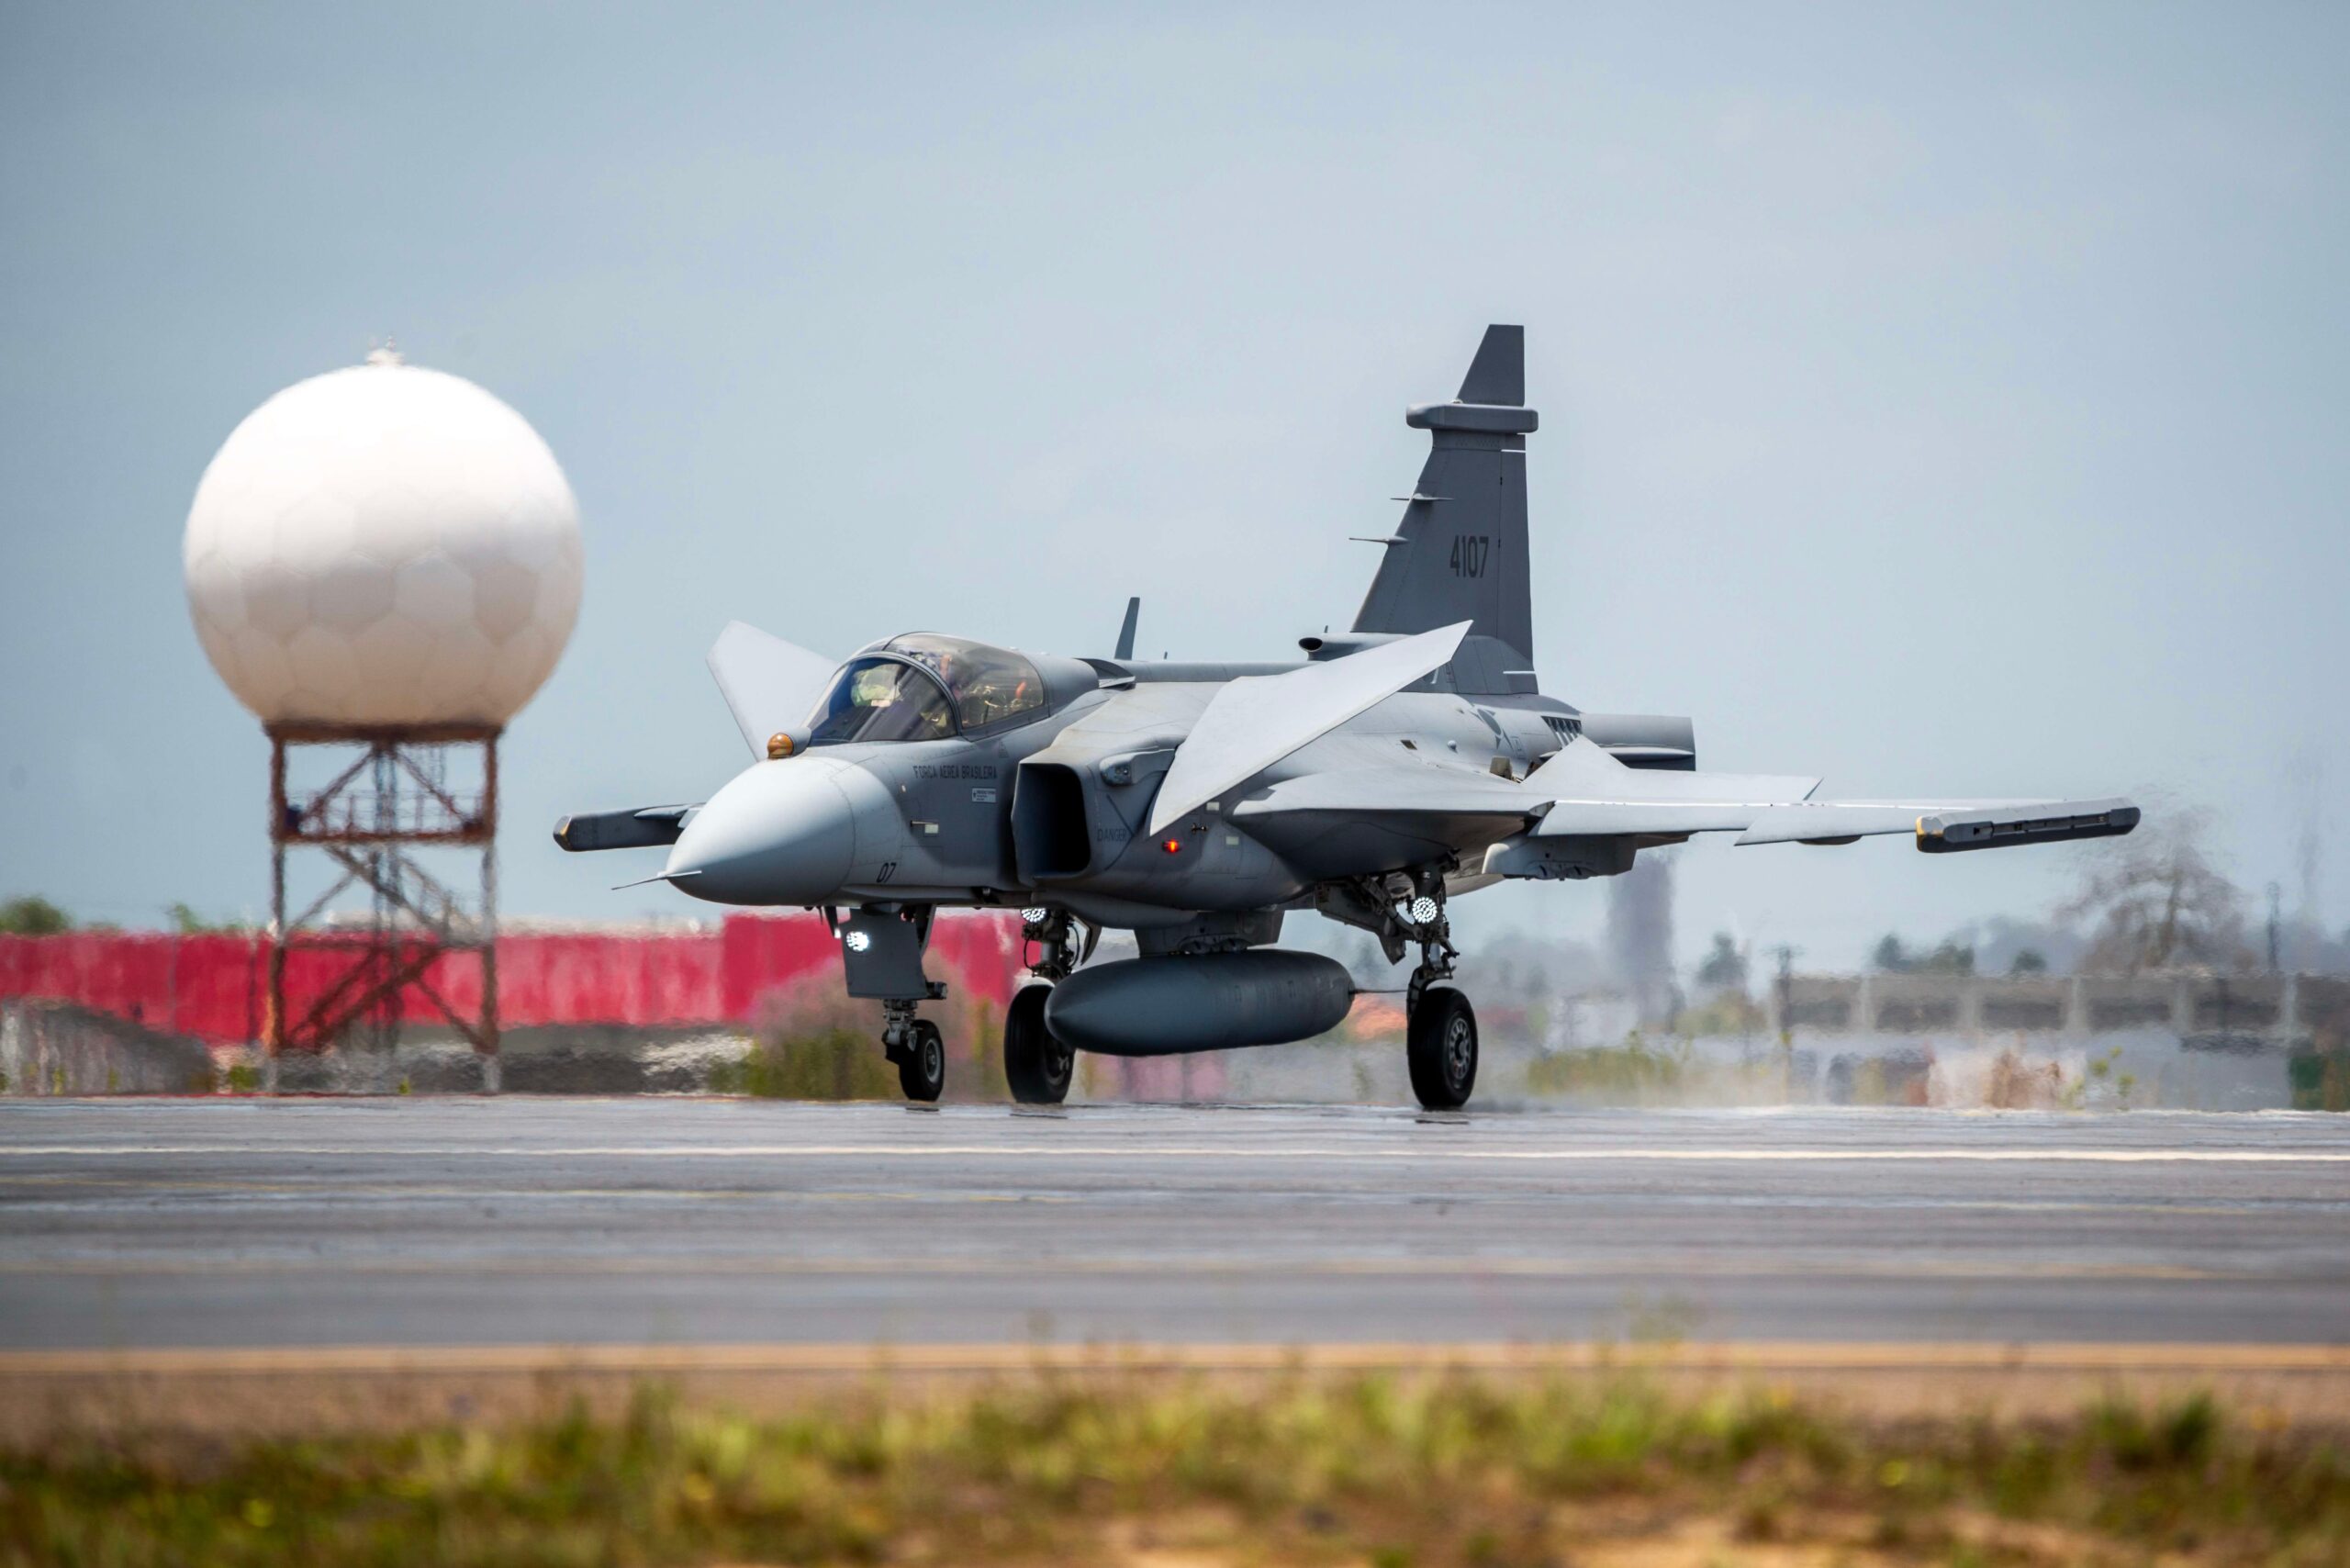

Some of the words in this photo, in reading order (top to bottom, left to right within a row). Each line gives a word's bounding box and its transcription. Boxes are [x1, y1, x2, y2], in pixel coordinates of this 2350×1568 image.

[1450, 535, 1489, 577] 4107
[1097, 828, 1127, 842] DANGER
[876, 862, 897, 883] 07
